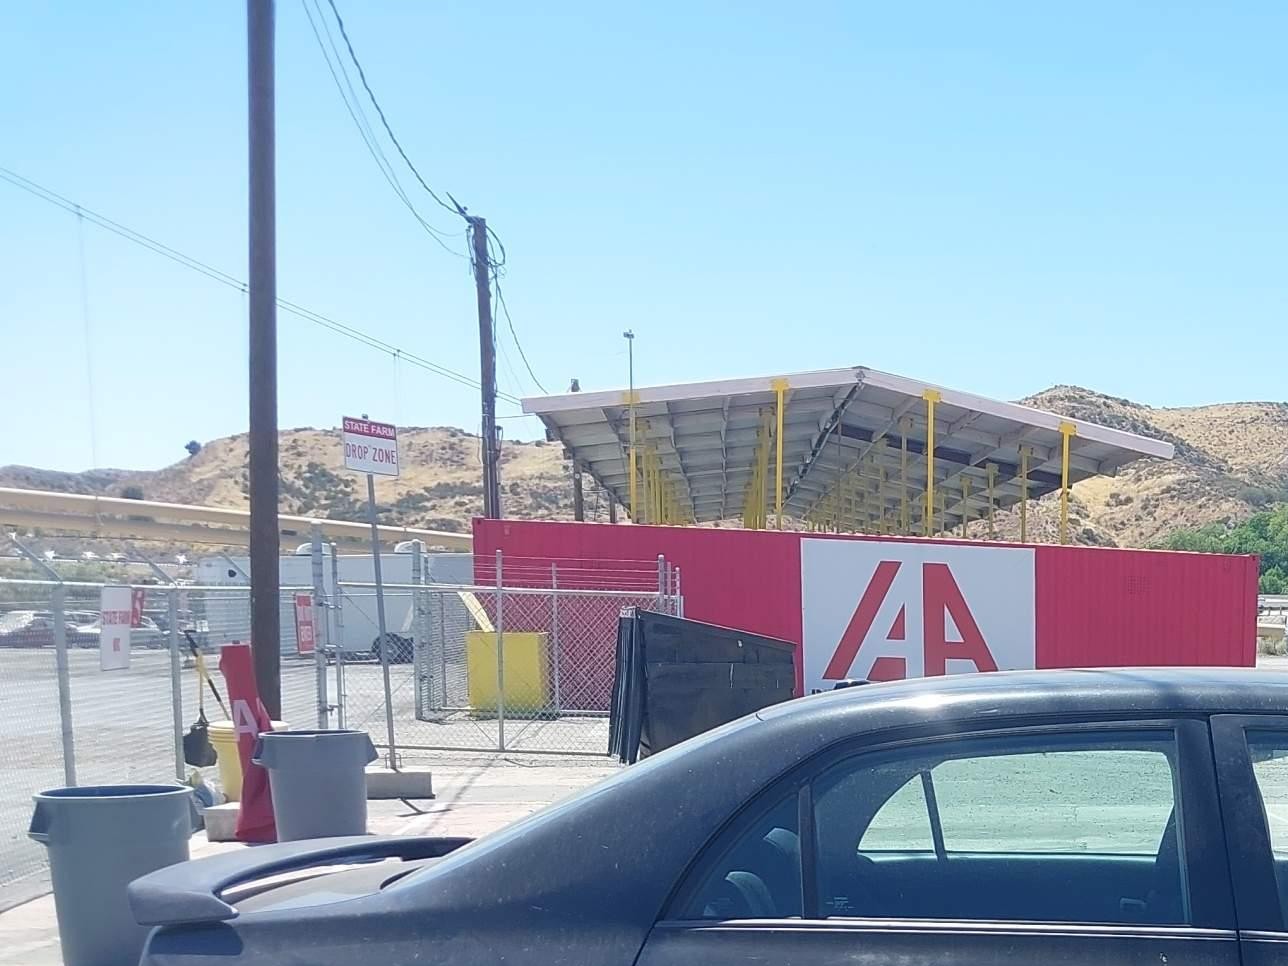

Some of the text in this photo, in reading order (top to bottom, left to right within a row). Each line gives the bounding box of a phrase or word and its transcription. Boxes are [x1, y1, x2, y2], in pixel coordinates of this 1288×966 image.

[344, 421, 395, 437] STATE FARM
[345, 442, 397, 465] DROP ZONE
